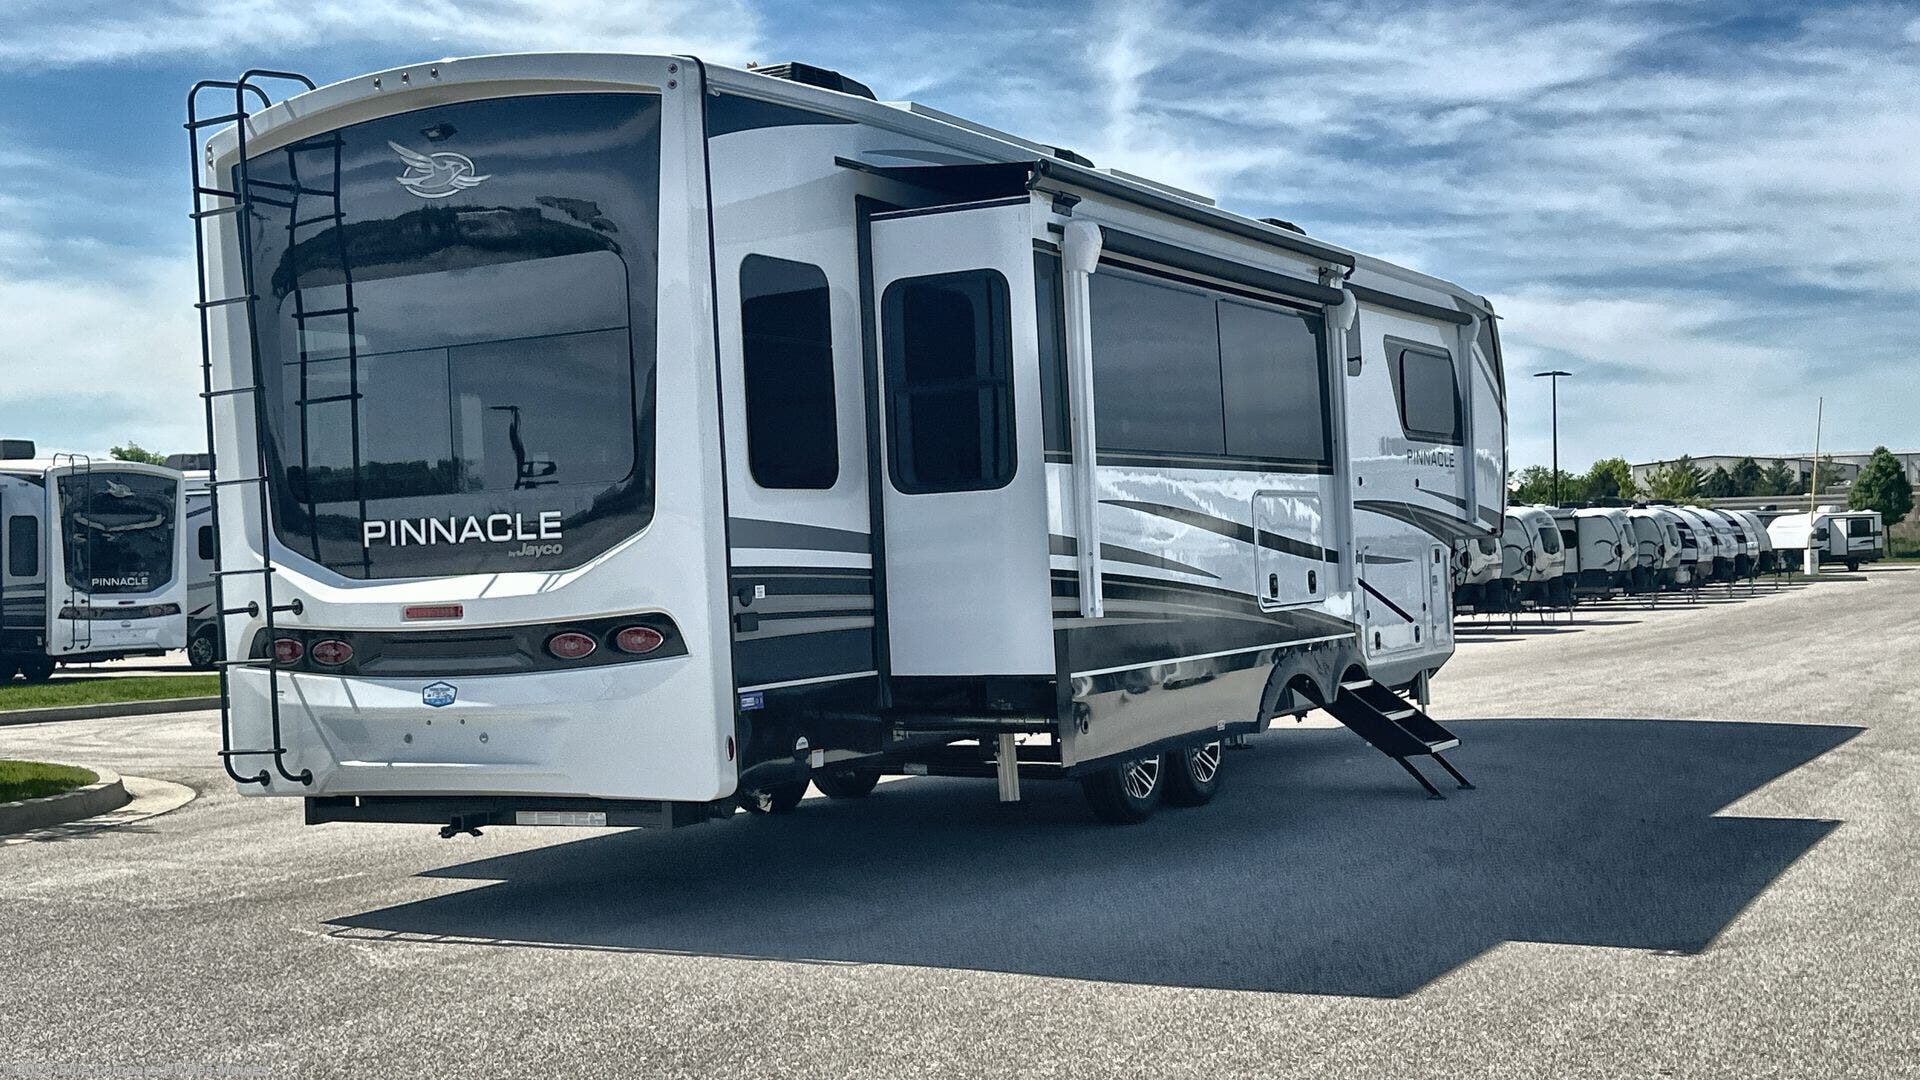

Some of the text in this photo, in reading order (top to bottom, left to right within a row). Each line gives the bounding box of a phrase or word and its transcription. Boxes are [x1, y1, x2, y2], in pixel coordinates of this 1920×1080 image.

[1407, 449, 1455, 468] PINNACLE
[364, 510, 563, 548] PINNACLE
[516, 542, 563, 558] Jayco
[91, 577, 148, 586] PINNACLE
